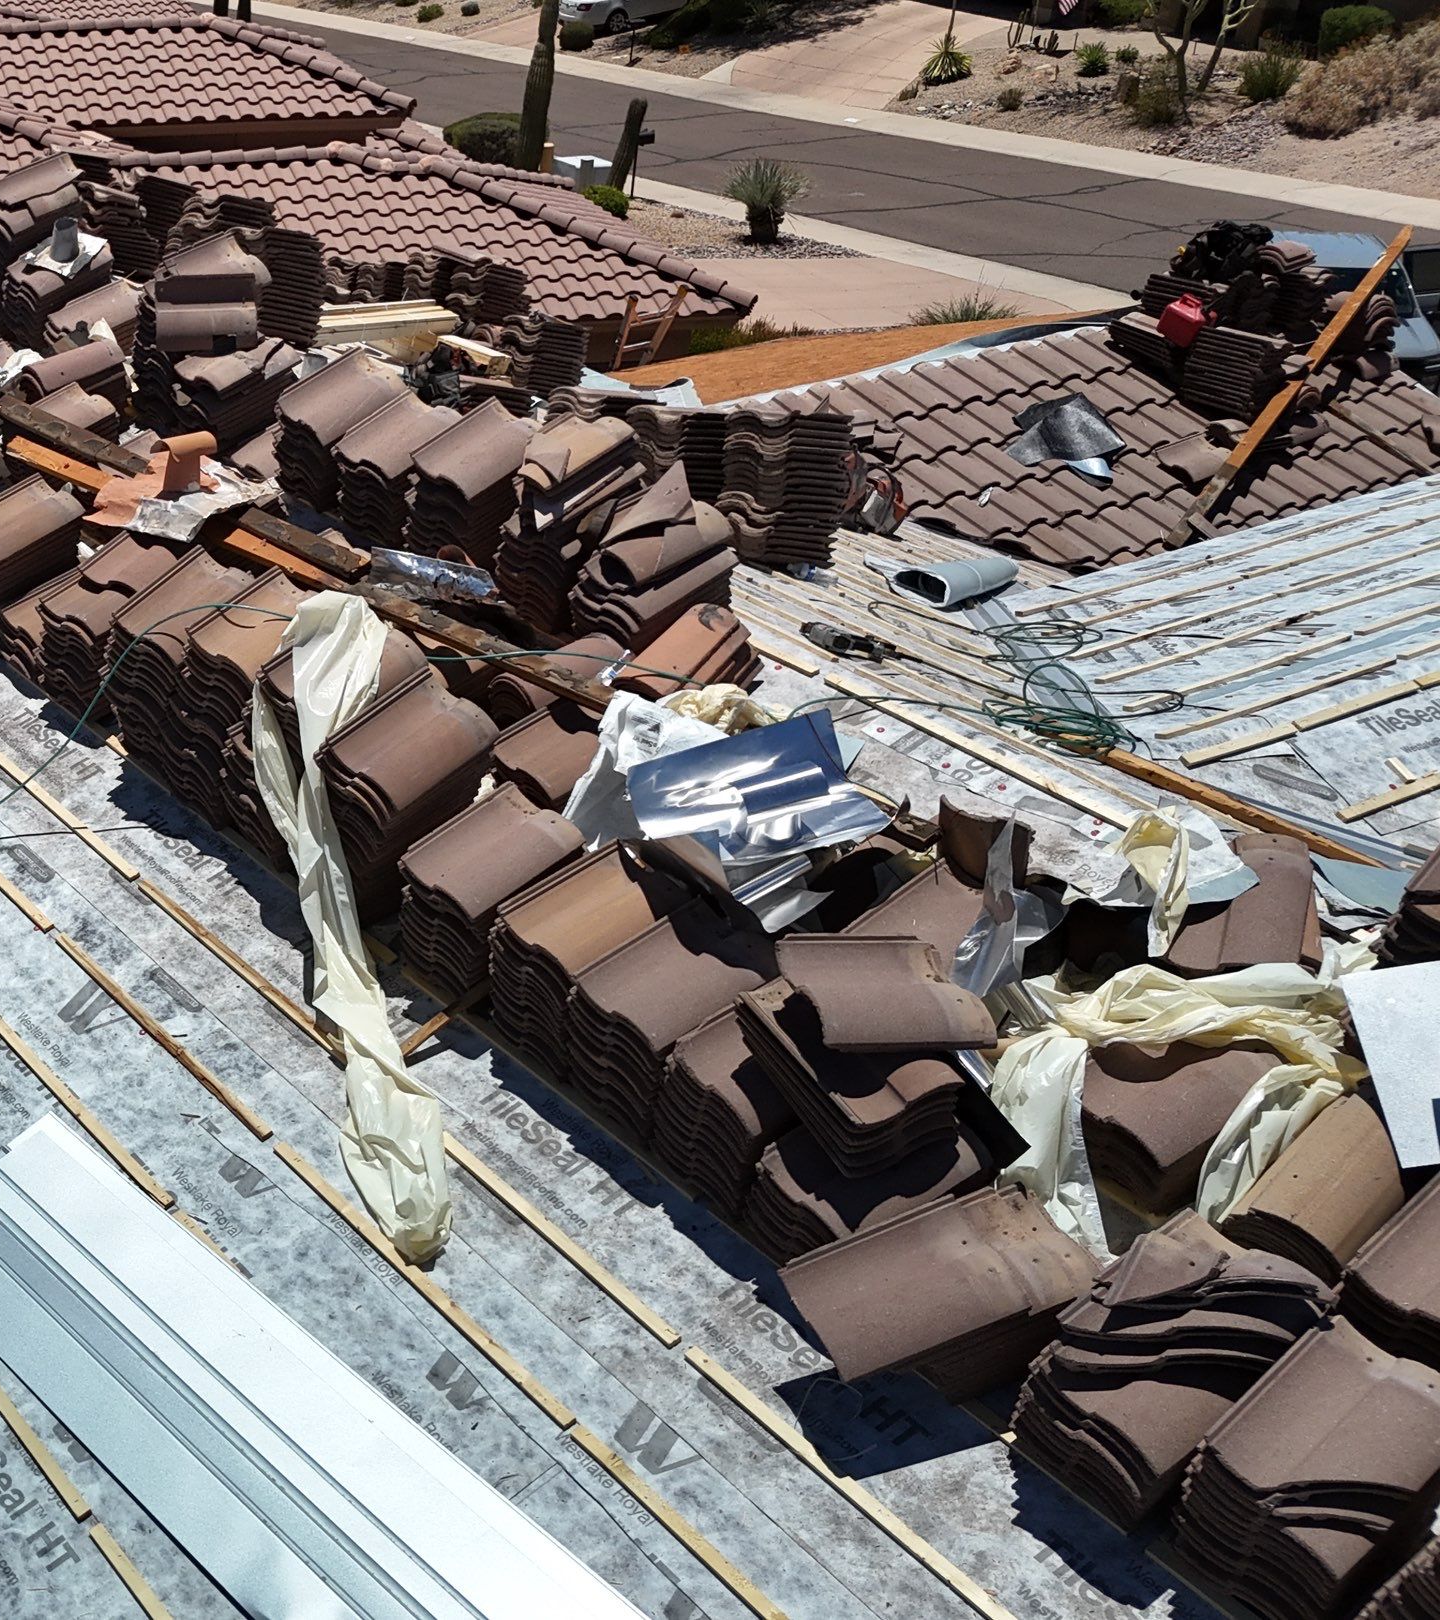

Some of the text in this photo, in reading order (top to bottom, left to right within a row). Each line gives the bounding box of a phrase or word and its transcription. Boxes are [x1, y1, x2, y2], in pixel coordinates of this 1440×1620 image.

[69, 756, 107, 783] HT
[16, 1011, 53, 1050] Westlake
[46, 1042, 74, 1071] Royal
[171, 1165, 244, 1239] Westlake Royal
[587, 1176, 647, 1218] HT
[325, 1210, 405, 1288] Westlake Royal
[371, 1370, 424, 1425] Westlake
[860, 1394, 934, 1447] HT
[555, 1431, 658, 1529] Westlake Royal
[25, 1519, 82, 1574] HT
